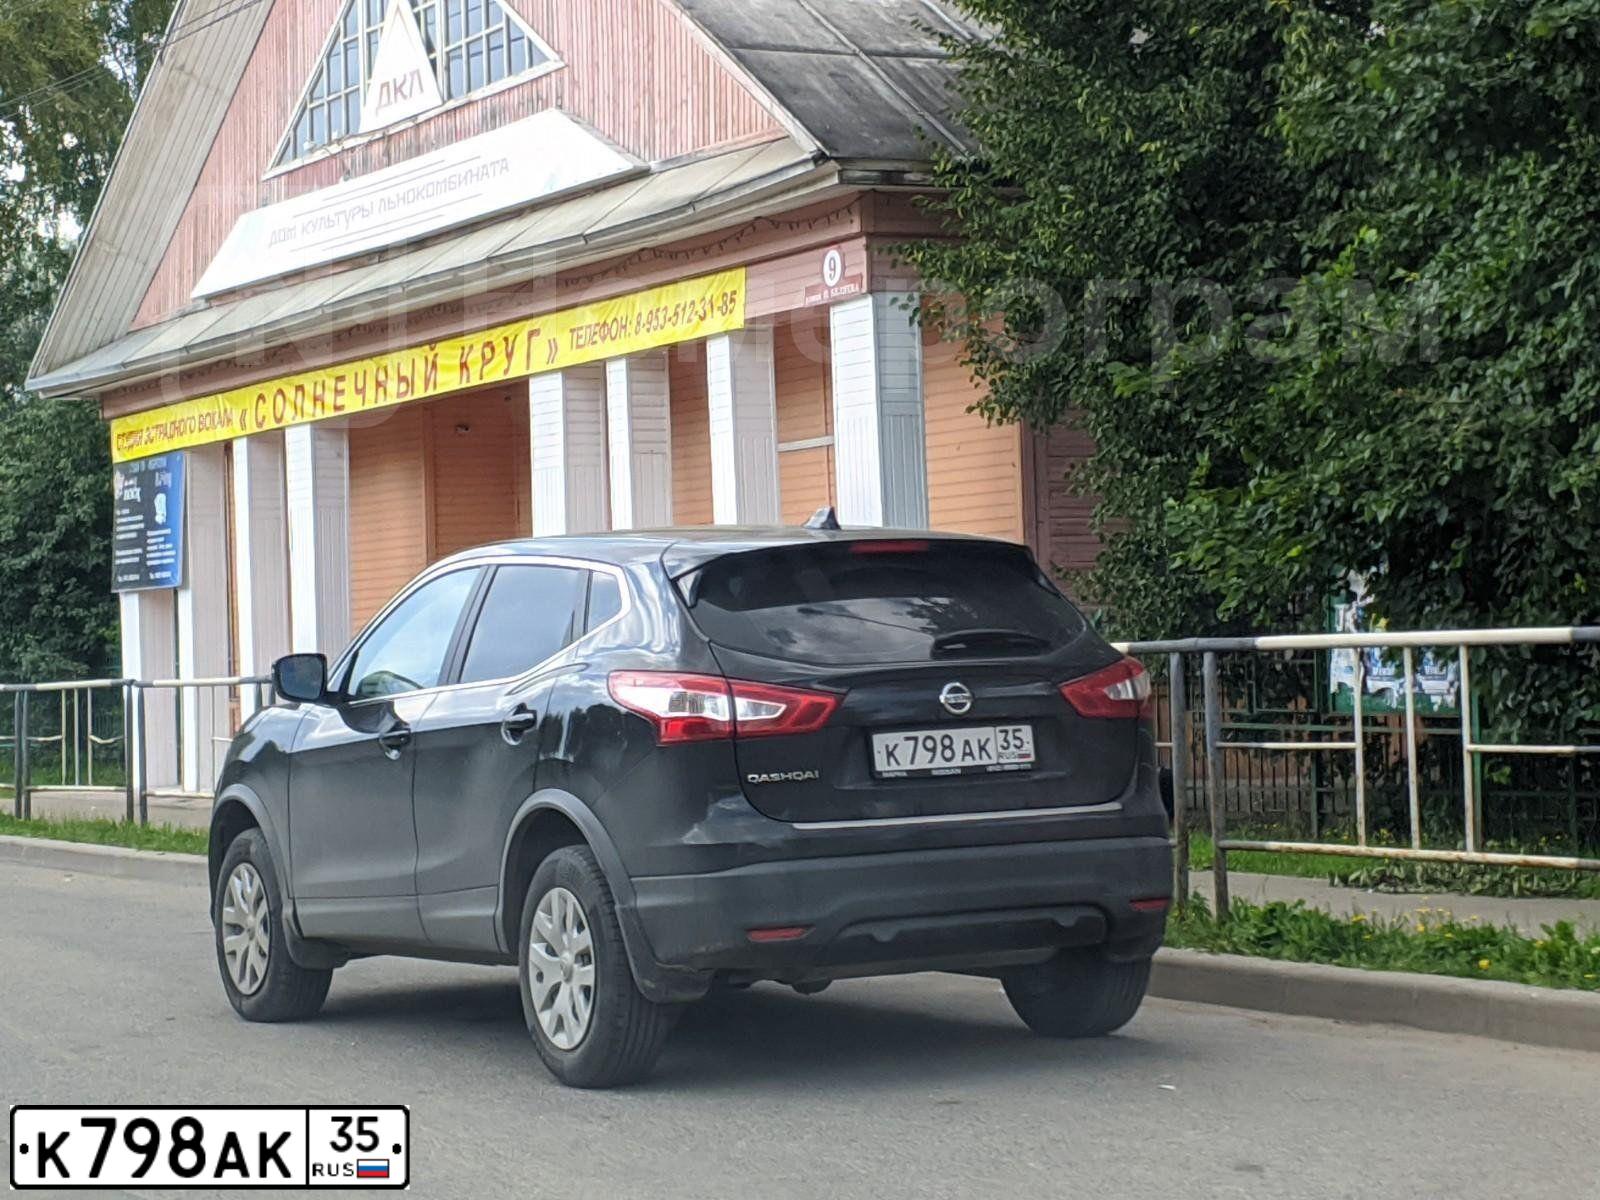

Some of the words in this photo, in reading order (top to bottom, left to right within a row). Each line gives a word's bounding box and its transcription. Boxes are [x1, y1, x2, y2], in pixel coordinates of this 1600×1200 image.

[375, 68, 425, 118] ДКЛ
[268, 226, 297, 248] ДОМ
[301, 203, 374, 235] КУЛЬТУРЫ
[378, 157, 510, 213] ЛЬНОКОМБИНАТА
[828, 256, 837, 282] 9
[146, 416, 198, 446] ЭСТРАДНОГО
[569, 316, 633, 351] ТЕЛЕФОН:
[634, 290, 737, 337] 8-953-512-31-85
[884, 734, 993, 767] К798АК
[998, 728, 1025, 750] 35
[747, 769, 820, 784] QASHQAI
